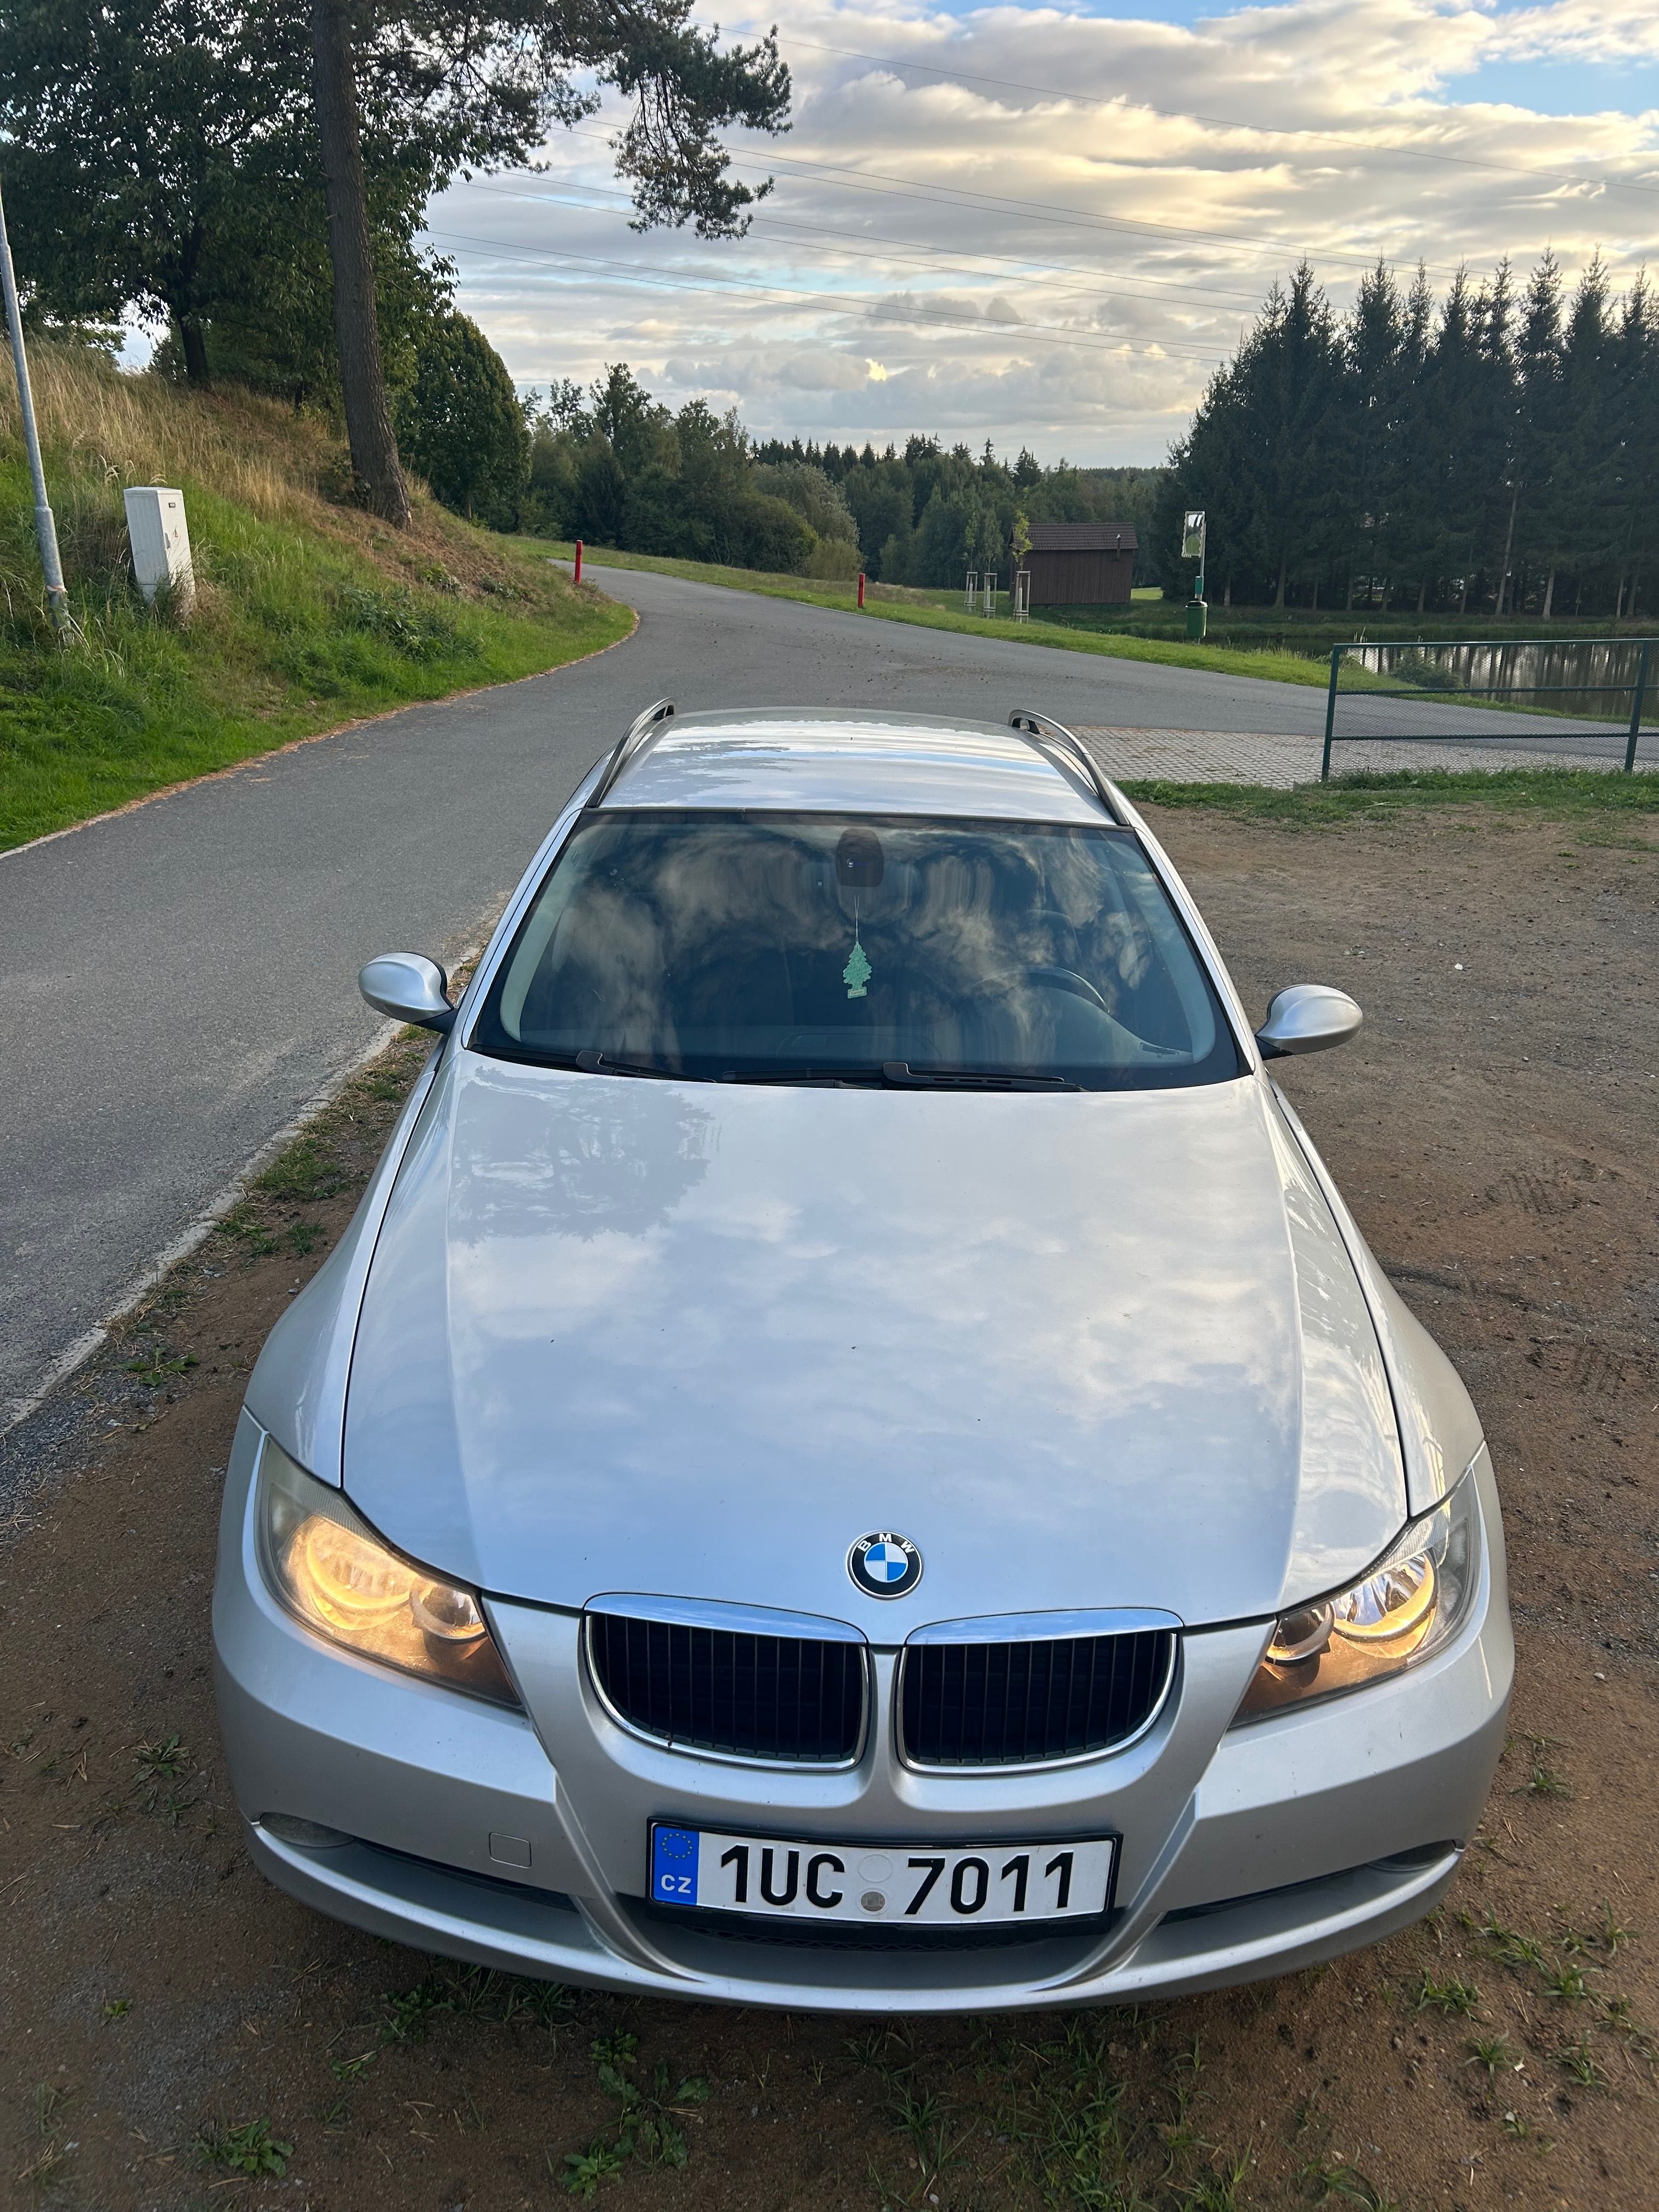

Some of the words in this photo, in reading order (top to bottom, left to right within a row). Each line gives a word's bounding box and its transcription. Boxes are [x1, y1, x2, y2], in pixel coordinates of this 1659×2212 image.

[857, 1533, 915, 1554] BMW
[661, 1874, 691, 1894] CZ
[720, 1844, 845, 1909] 1UC
[904, 1851, 1075, 1915] 7011
